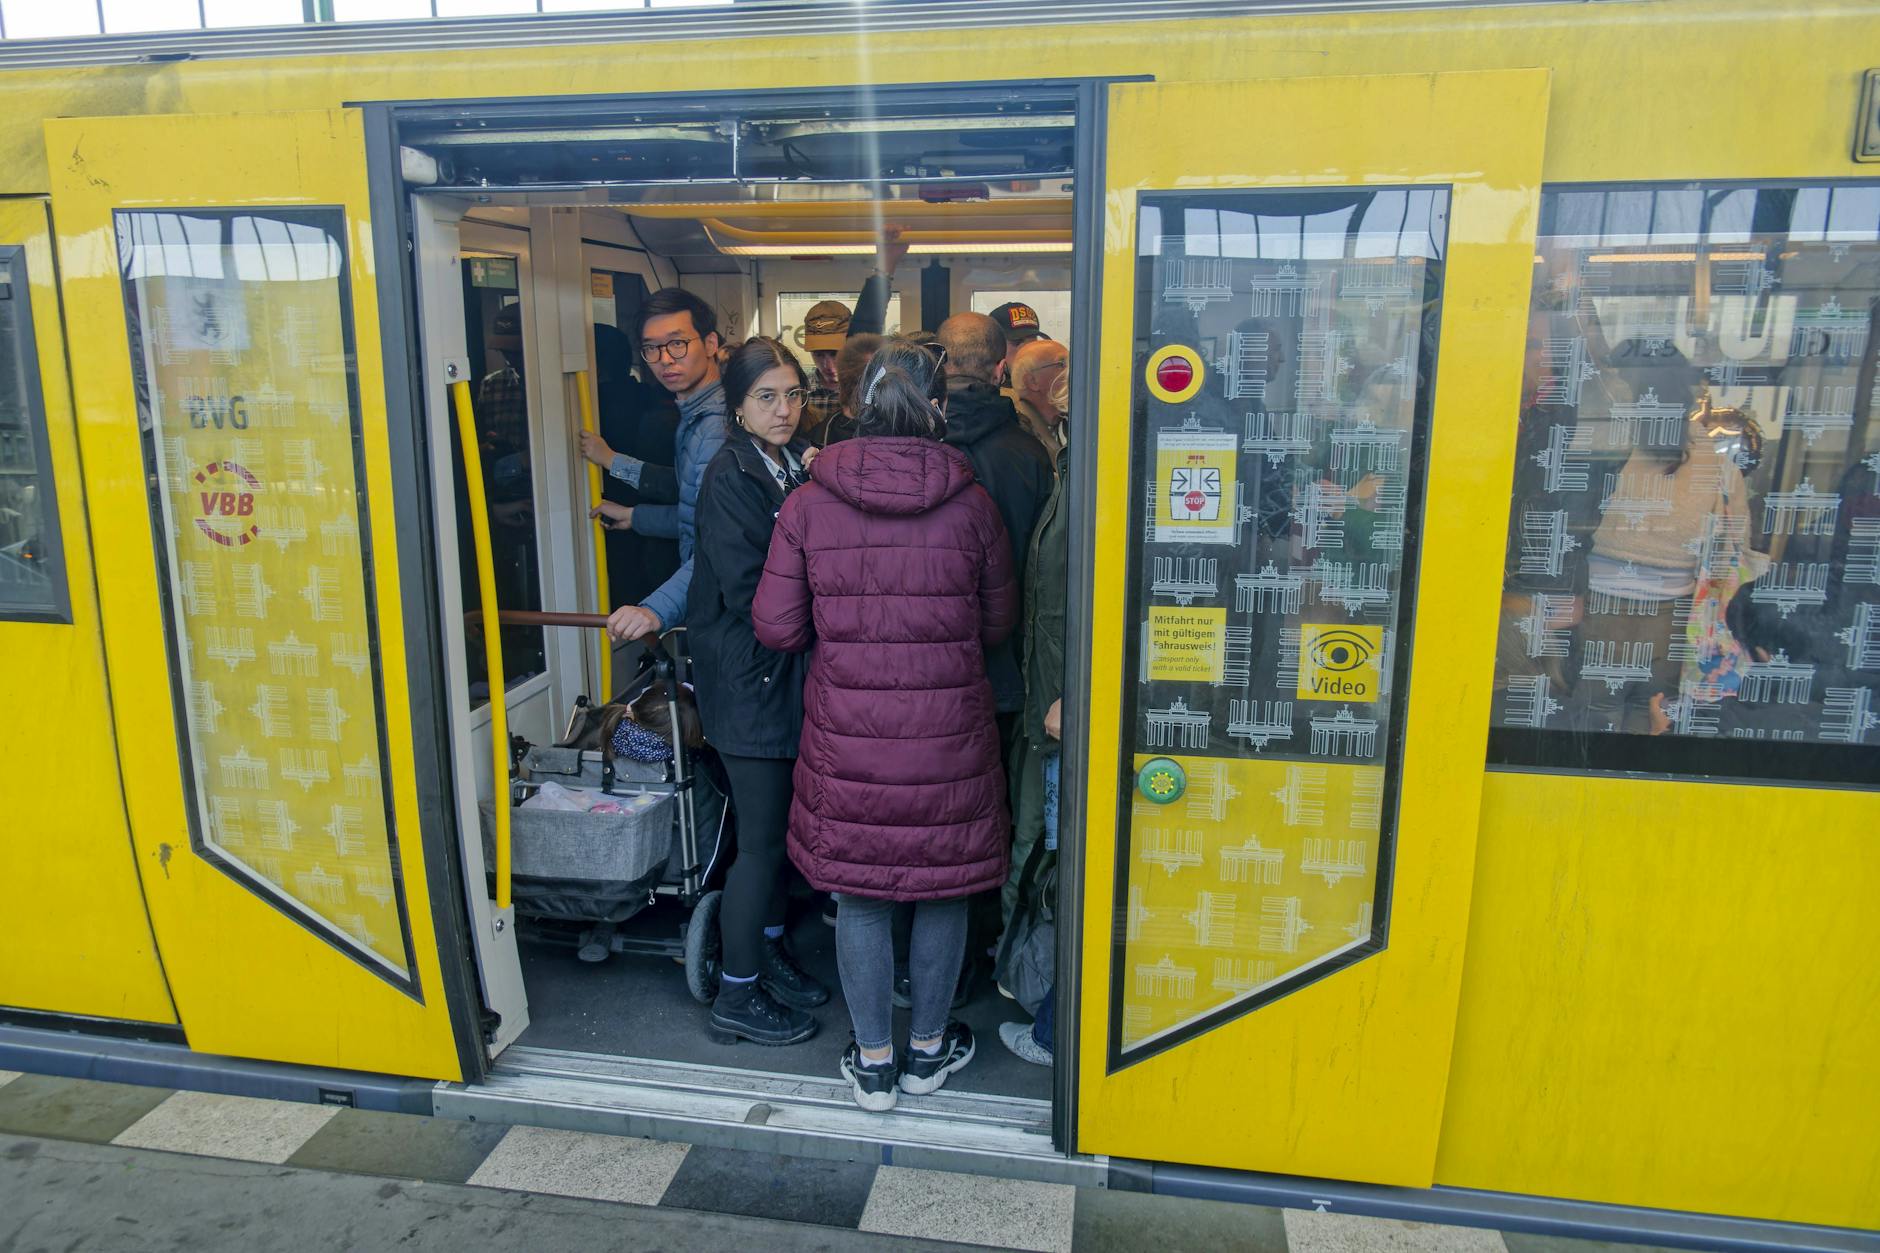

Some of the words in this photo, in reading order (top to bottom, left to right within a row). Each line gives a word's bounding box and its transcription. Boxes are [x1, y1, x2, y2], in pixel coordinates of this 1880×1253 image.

[189, 395, 249, 430] BVG
[200, 492, 254, 516] VBB
[1185, 497, 1205, 505] STOP
[1154, 615, 1194, 625] Mitfahrt
[1197, 618, 1214, 626] nur
[1153, 627, 1170, 637] mit
[1172, 628, 1216, 640] gültigem
[1153, 641, 1216, 651] Fahrausweis!
[1185, 655, 1200, 665] only
[1174, 664, 1192, 672] valid
[1311, 676, 1366, 696] Video
